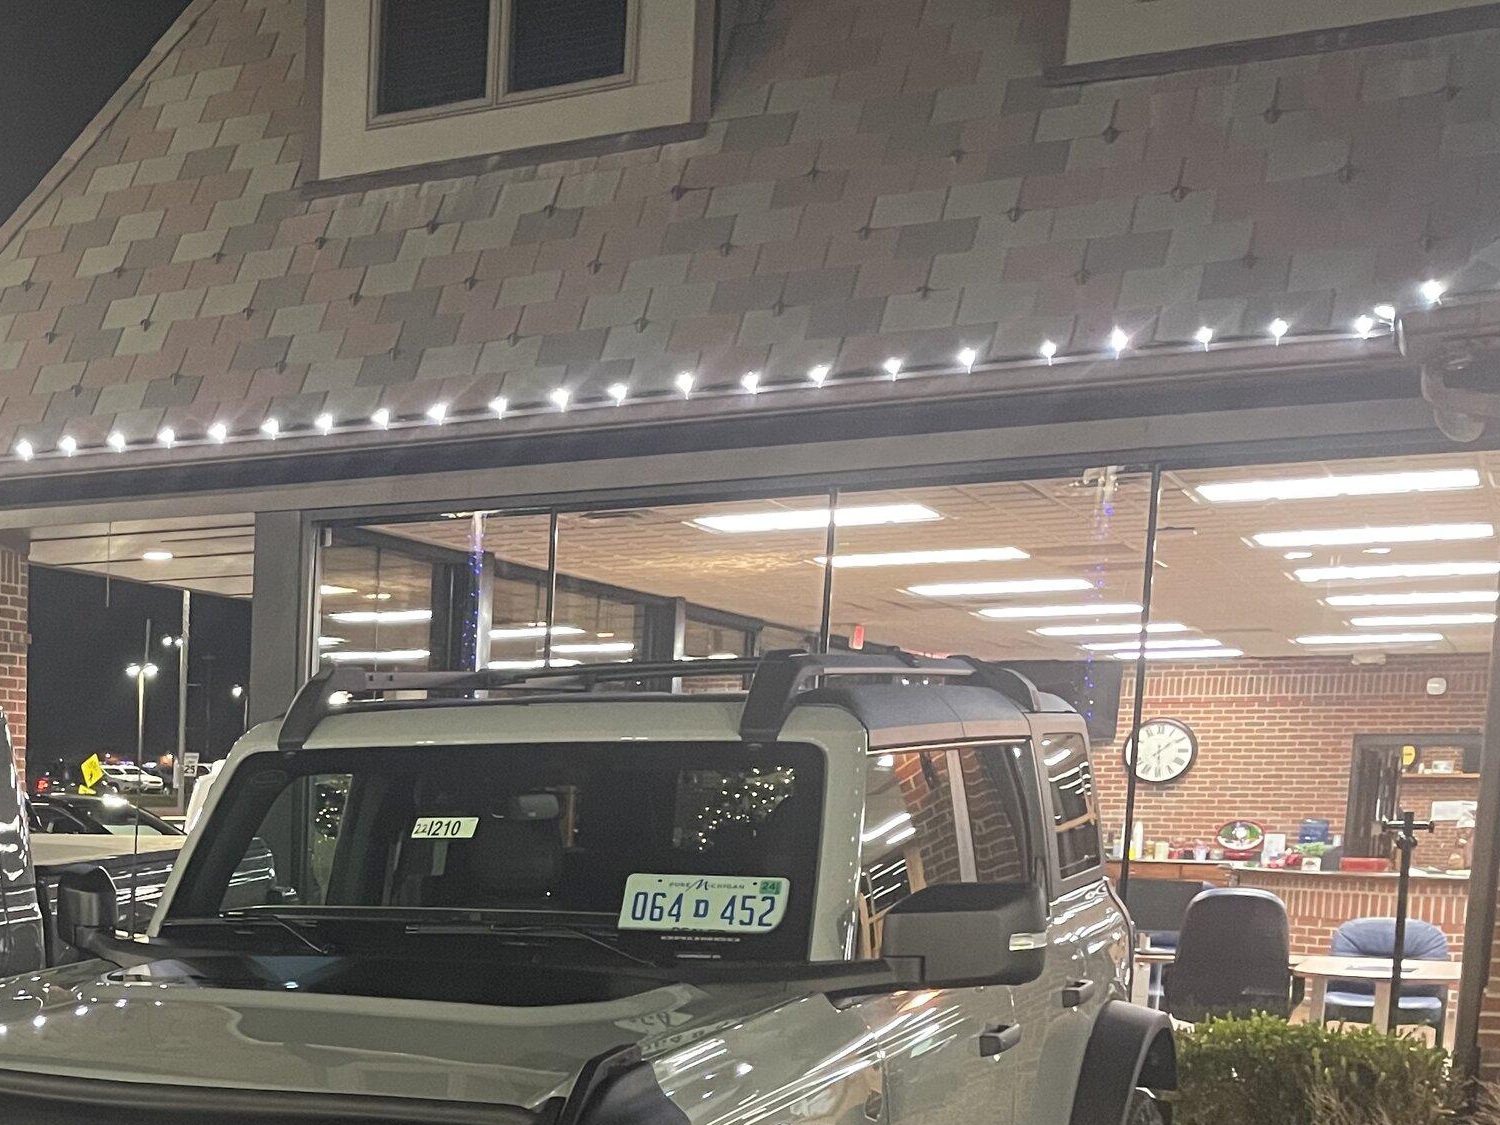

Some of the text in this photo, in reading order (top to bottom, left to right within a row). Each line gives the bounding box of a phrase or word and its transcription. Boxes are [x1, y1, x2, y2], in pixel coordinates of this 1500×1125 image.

[184, 765, 196, 774] 25
[631, 891, 776, 927] 064 D 452
